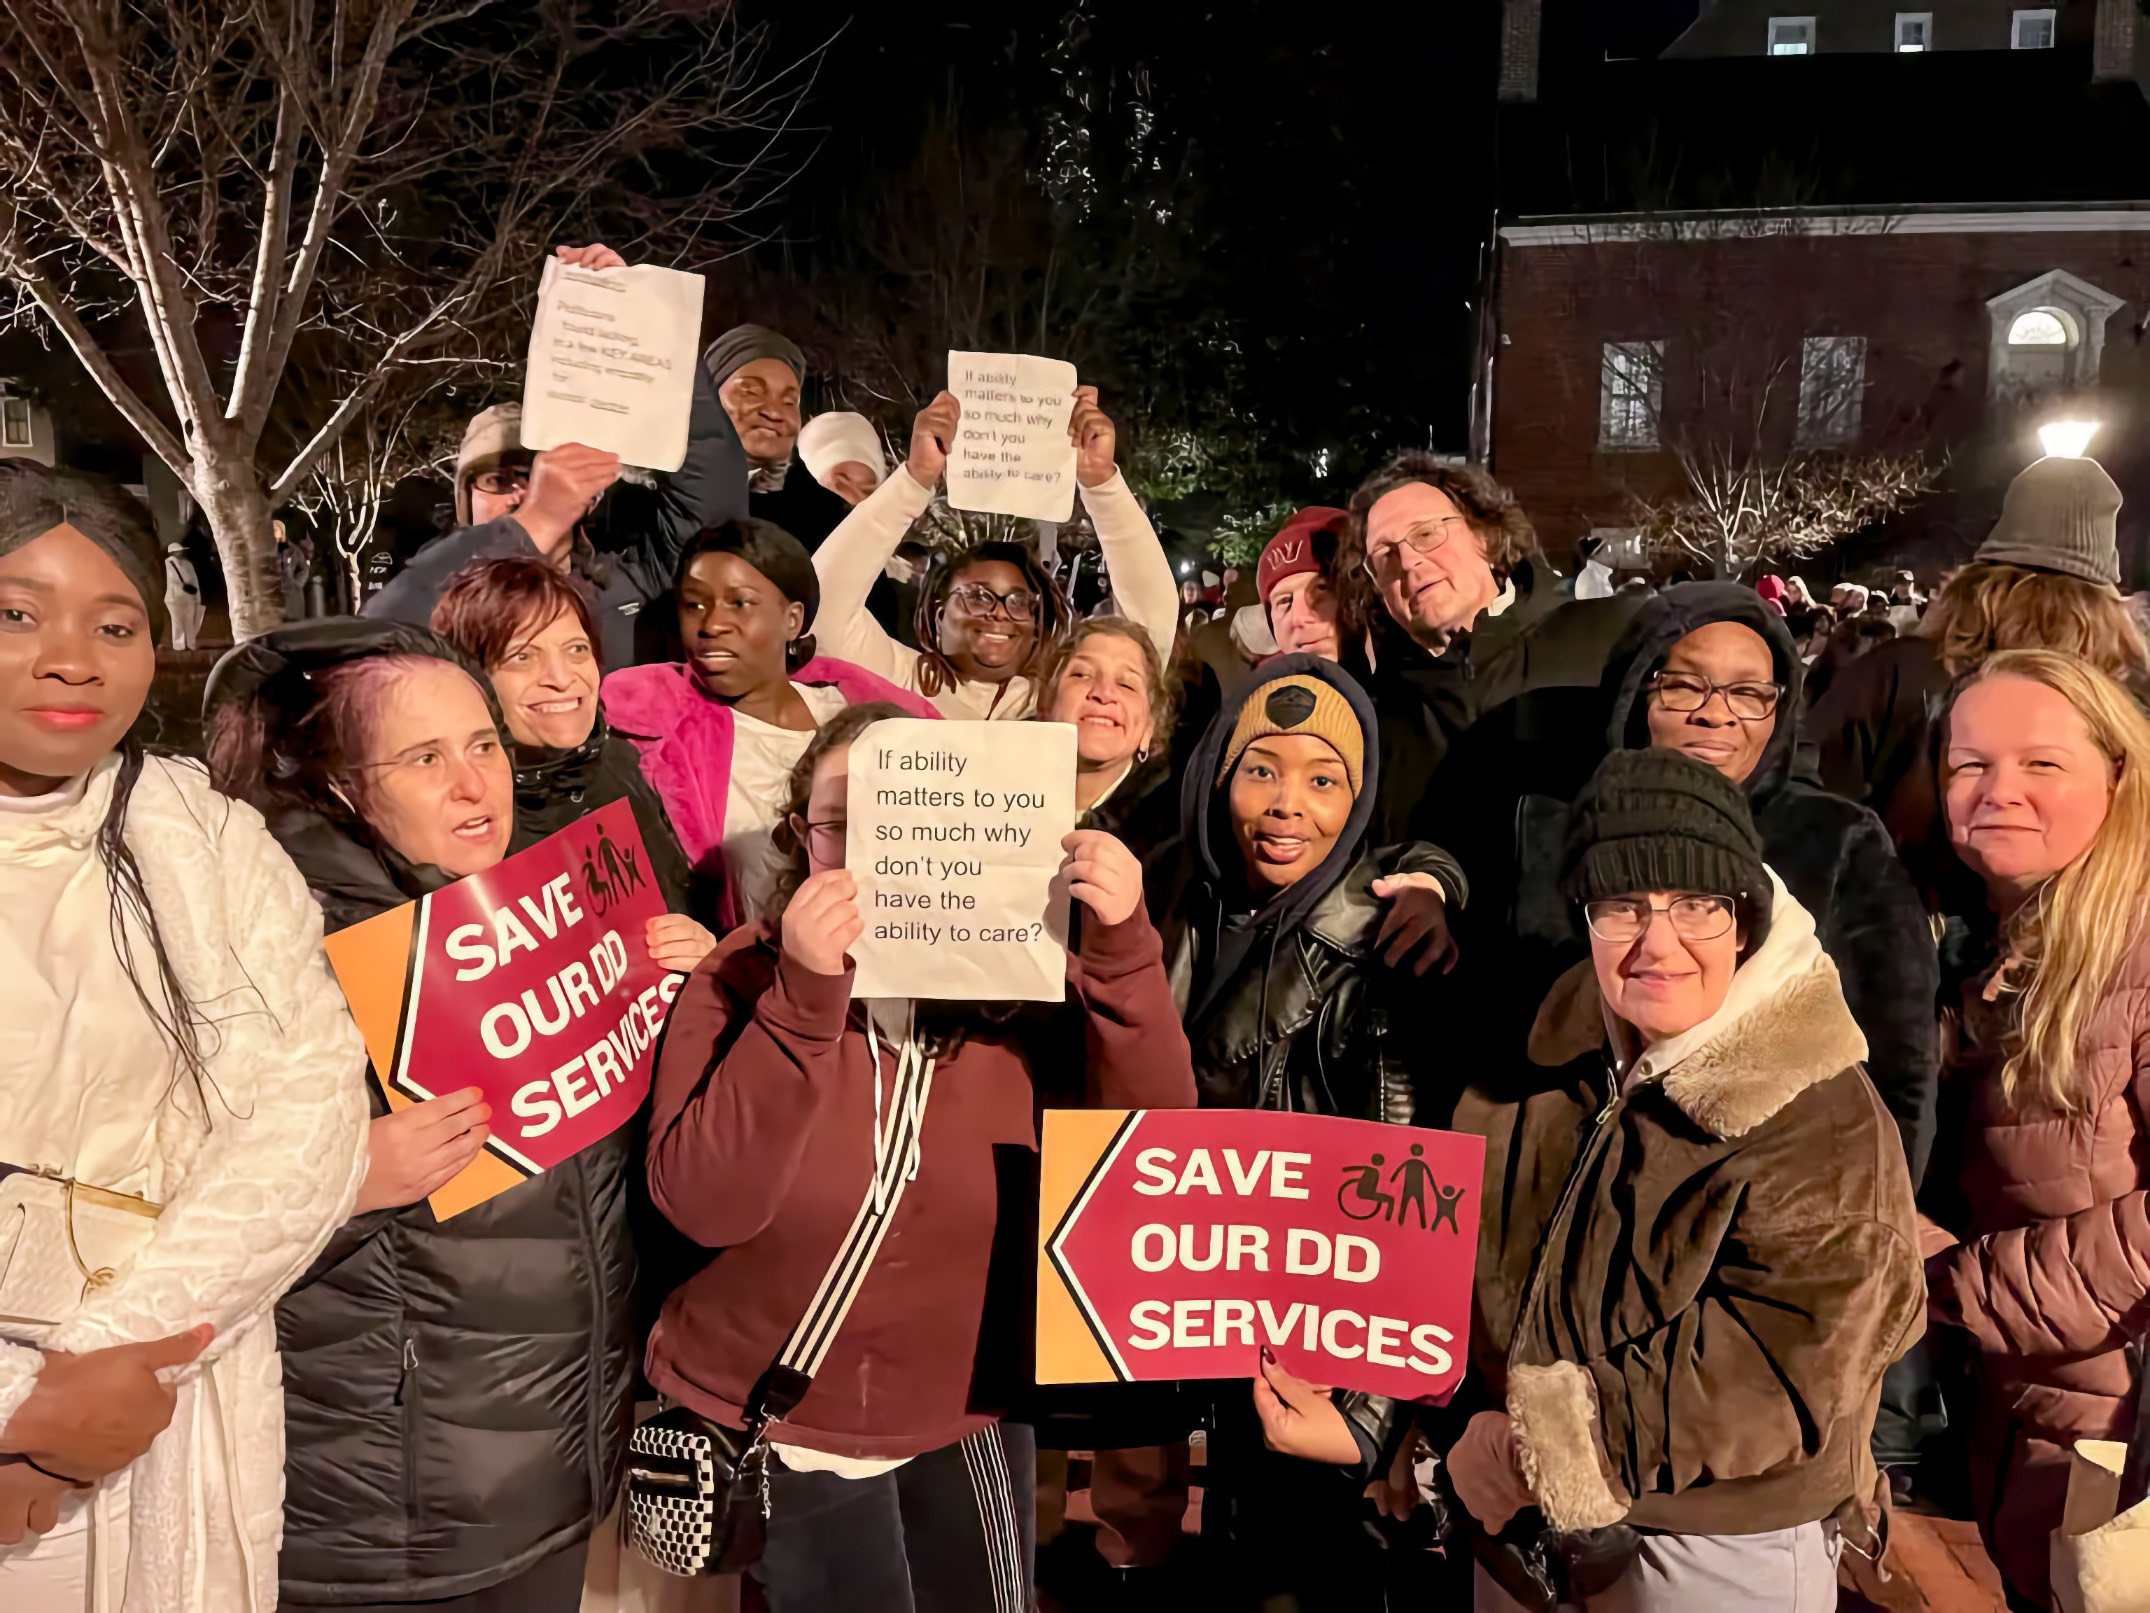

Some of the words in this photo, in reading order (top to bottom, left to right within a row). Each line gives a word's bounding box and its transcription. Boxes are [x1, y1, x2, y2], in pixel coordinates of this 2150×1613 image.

[965, 388, 1015, 403] matters
[1020, 394, 1033, 404] to
[1037, 396, 1062, 408] you
[964, 410, 981, 420] so
[985, 410, 1021, 424] much
[1026, 414, 1054, 430] why
[1001, 433, 1026, 446] you
[964, 448, 996, 460] have
[1001, 451, 1022, 462] the
[878, 749, 894, 770] If
[900, 751, 968, 777] ability
[876, 786, 964, 807] matters
[974, 789, 994, 808] to
[1003, 792, 1045, 812] you
[875, 825, 903, 841] so
[912, 822, 975, 842] much
[984, 822, 1032, 847] why
[875, 856, 934, 876] don't
[940, 860, 982, 881] you
[875, 890, 931, 909] have
[940, 892, 976, 910] the
[445, 871, 584, 982] SAVE
[875, 922, 941, 946] ability
[950, 924, 970, 942] to
[978, 923, 1042, 943] care?
[480, 961, 599, 1059] OUR
[589, 929, 628, 995] DD
[1132, 1146, 1312, 1200] SAVE
[1130, 1223, 1270, 1273] OUR
[1285, 1228, 1381, 1283] DD
[1127, 1299, 1454, 1376] SERVICES
